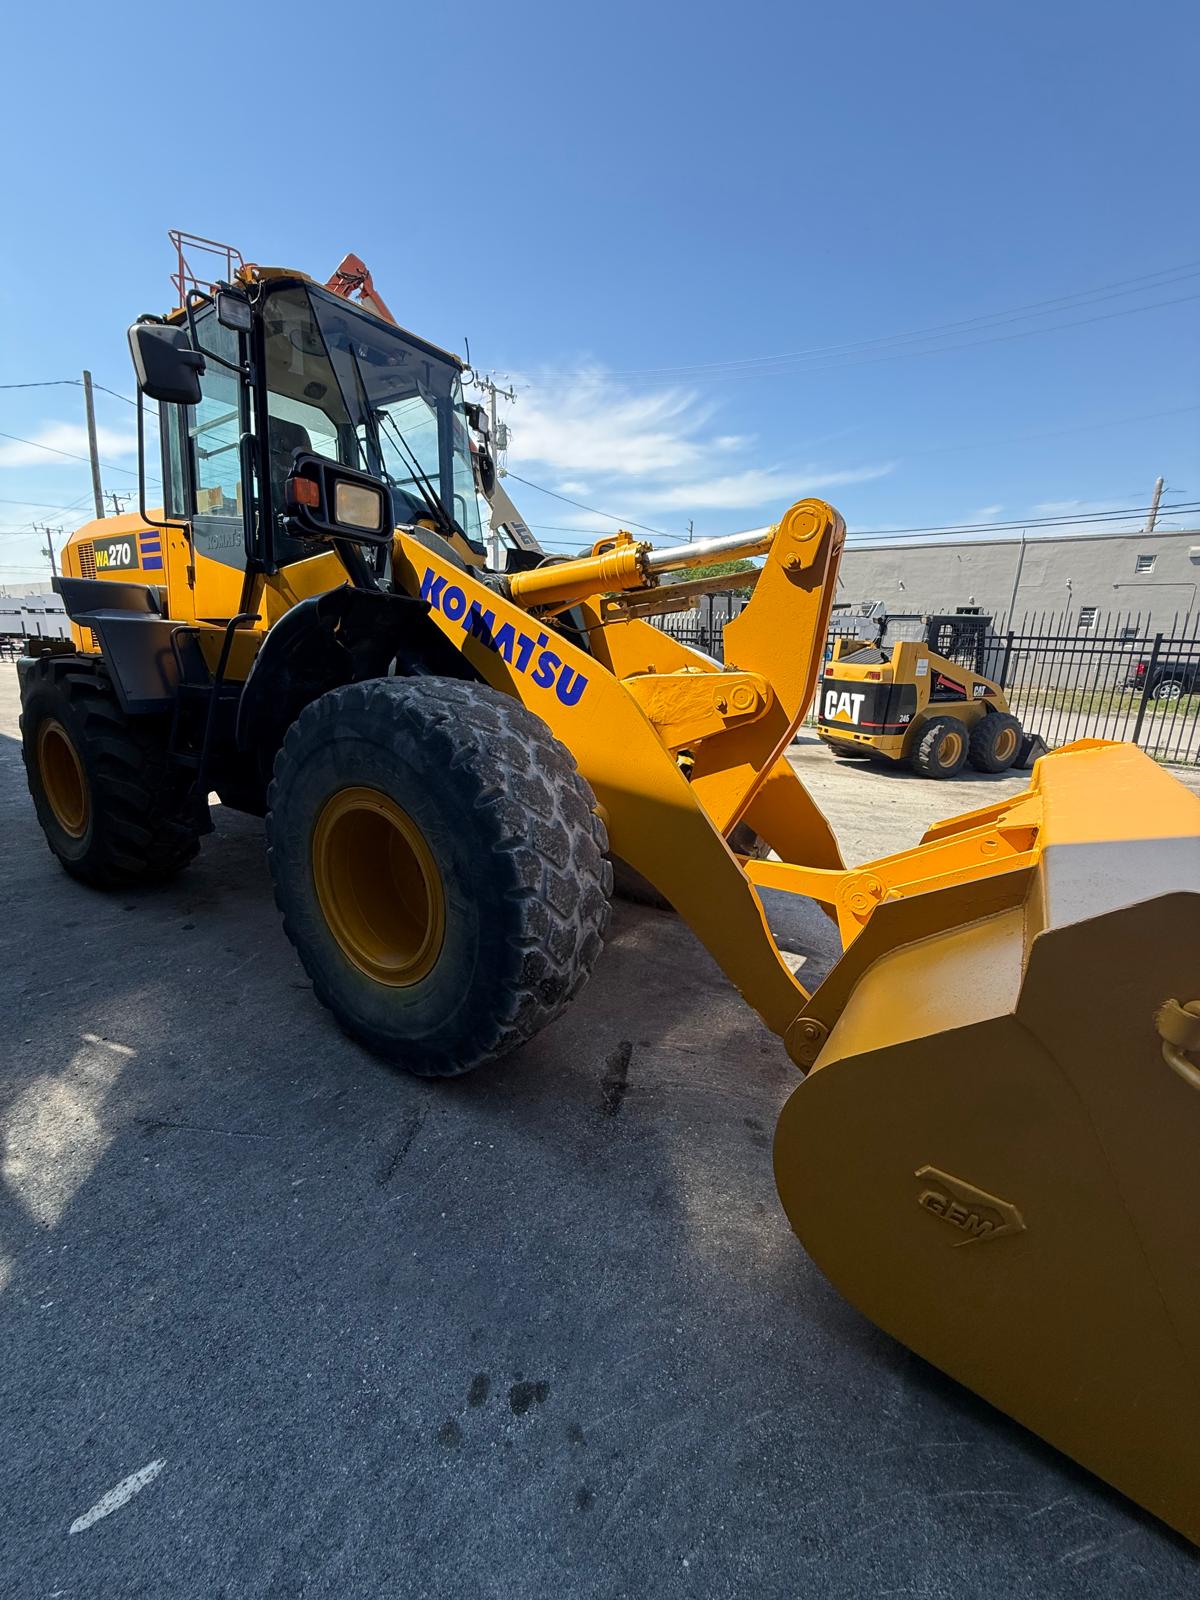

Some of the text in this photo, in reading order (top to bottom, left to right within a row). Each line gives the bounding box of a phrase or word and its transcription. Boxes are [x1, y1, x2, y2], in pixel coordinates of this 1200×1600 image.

[207, 528, 242, 549] KOMATS
[95, 543, 131, 567] WA270
[420, 567, 589, 706] KOMATSU
[973, 685, 986, 697] CAT
[824, 690, 865, 725] CAT
[918, 1190, 994, 1238] GEM
